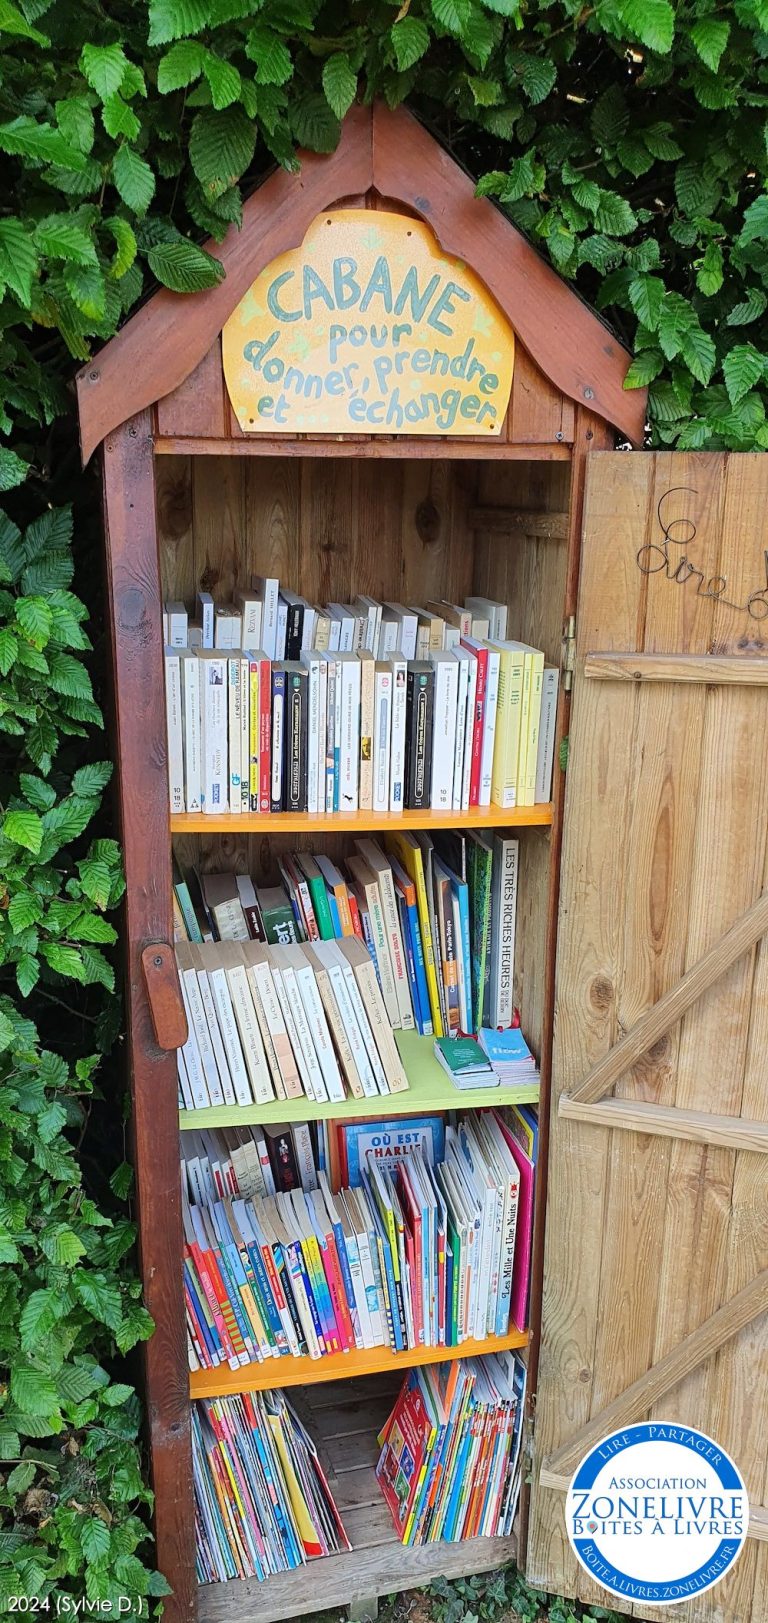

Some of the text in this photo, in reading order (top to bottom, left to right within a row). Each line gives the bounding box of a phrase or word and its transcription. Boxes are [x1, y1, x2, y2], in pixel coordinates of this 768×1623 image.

[267, 256, 471, 336] CABANE
[329, 323, 412, 363] pour
[243, 331, 499, 398] donner, prendre
[257, 387, 497, 429] et échanger
[241, 781, 248, 800] 10 18
[375, 920, 383, 932] une
[499, 847, 516, 989] LES TRÈS RICHES HEURES
[376, 932, 385, 947] Pour
[371, 1132, 420, 1147] OÙ EST
[500, 1202, 517, 1299] Les Mille et Une Nuits
